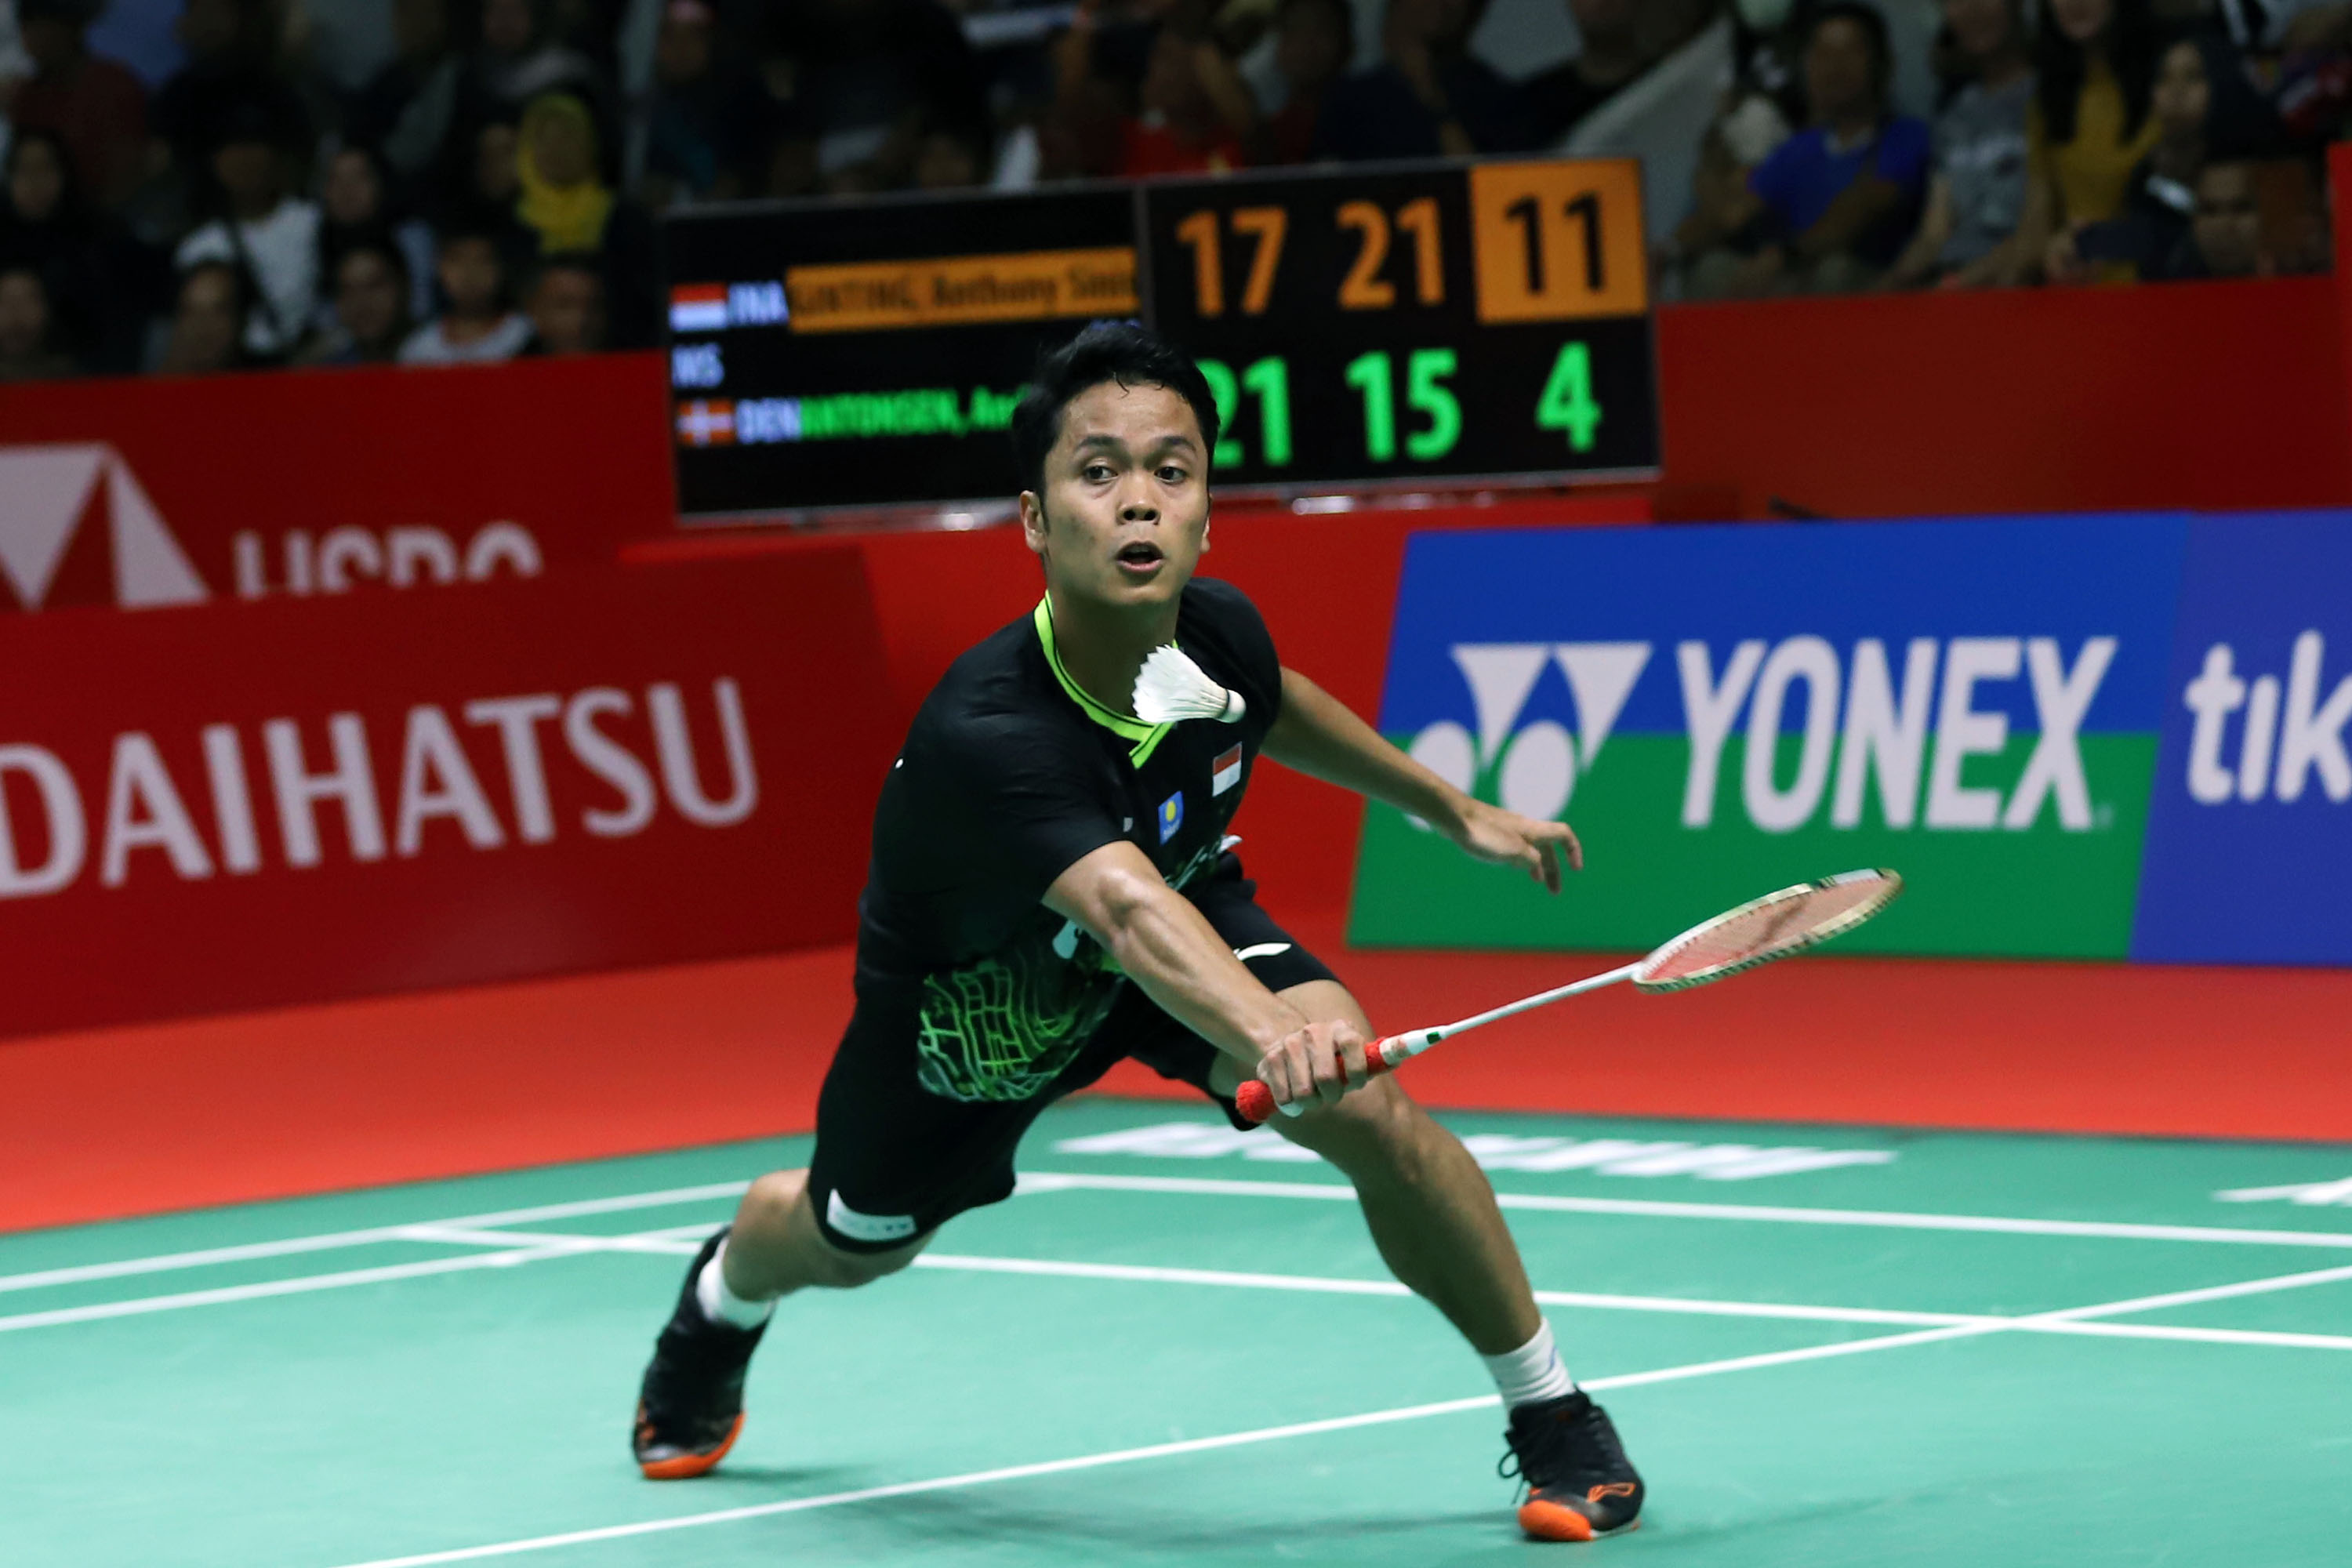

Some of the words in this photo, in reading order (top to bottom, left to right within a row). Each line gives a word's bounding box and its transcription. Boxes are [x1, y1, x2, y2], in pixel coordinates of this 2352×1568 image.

[1178, 207, 1289, 317] 17
[1337, 198, 1445, 307] 21
[1507, 192, 1605, 295] 11
[1345, 347, 1462, 462] 15
[1535, 339, 1602, 452] 4
[0, 677, 759, 899] DAIHATSU
[1675, 633, 2118, 833] YONEX
